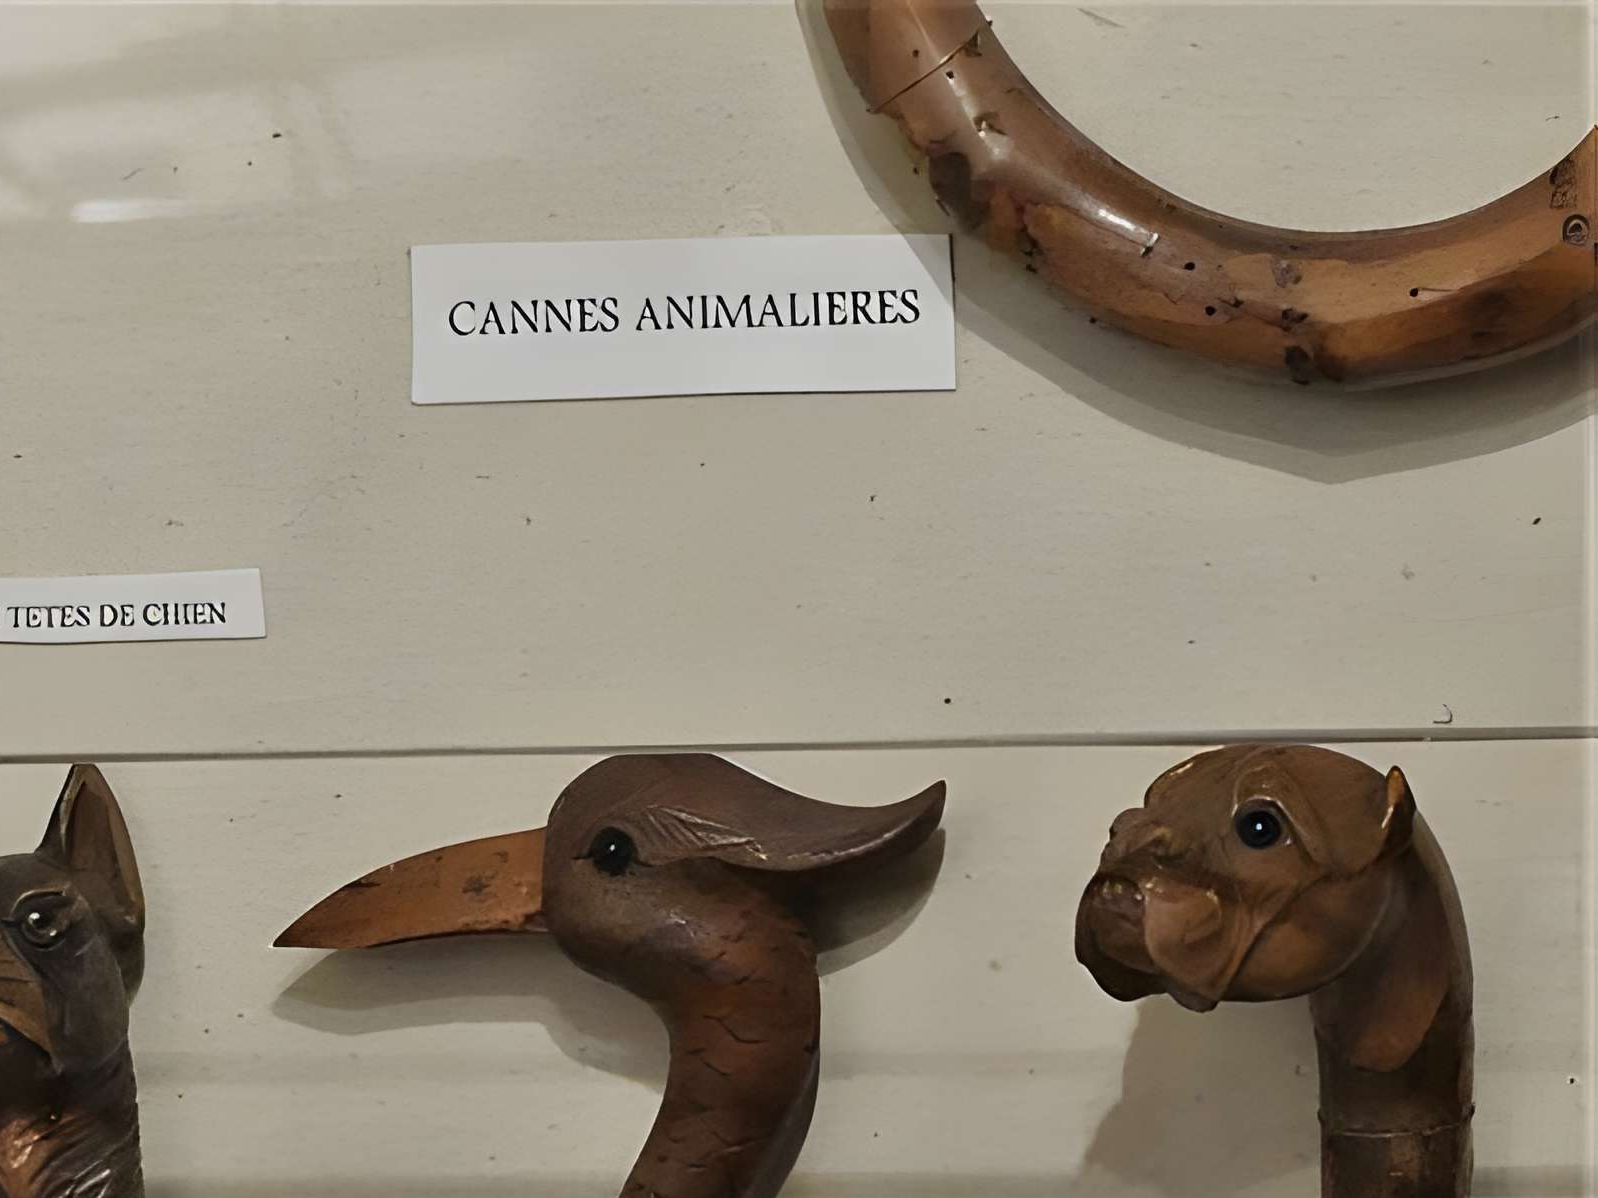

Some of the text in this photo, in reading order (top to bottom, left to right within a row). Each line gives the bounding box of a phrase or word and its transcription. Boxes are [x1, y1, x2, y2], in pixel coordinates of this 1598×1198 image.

[448, 288, 921, 337] CANNES ANIMALIERES
[6, 603, 91, 629] TETES
[99, 603, 135, 628] DE
